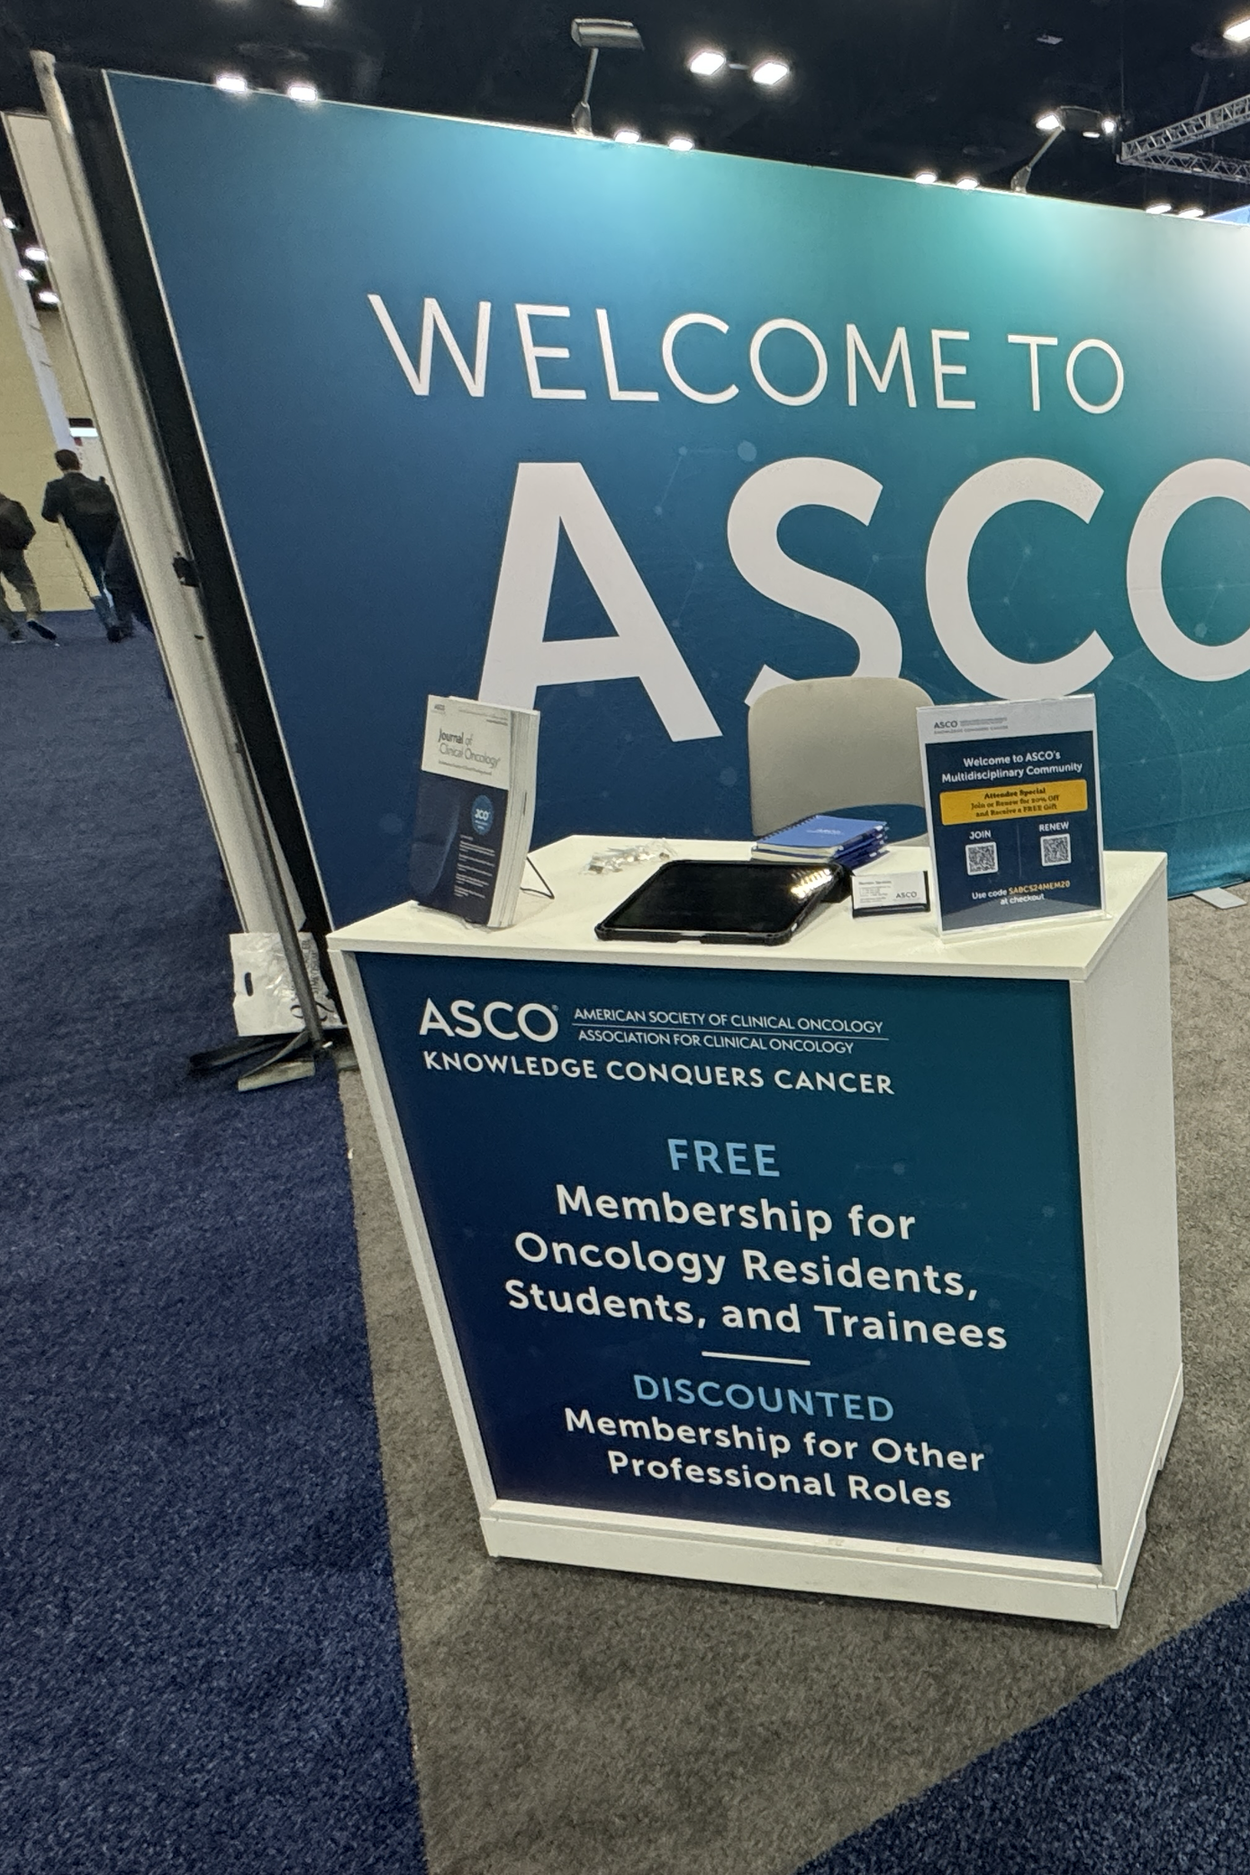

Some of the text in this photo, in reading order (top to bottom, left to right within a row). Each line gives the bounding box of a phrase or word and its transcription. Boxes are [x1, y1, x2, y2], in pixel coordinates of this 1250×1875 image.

[367, 294, 1124, 414] WELCOME TO
[934, 720, 958, 729] ASCO
[438, 728, 464, 745] Journal
[440, 742, 463, 758] Clinical
[465, 747, 501, 769] Oncology
[963, 751, 1061, 768] Welcome to ASCO's
[942, 762, 1083, 784] Multidisciplinary Community
[984, 787, 1046, 799] Attendee Special
[971, 802, 985, 810] Join
[990, 807, 1016, 816] Receive
[969, 830, 991, 840] JOIN
[1038, 822, 1069, 832] RENEW
[896, 891, 917, 899] ASCO
[972, 892, 986, 900] Use
[988, 888, 1007, 898] code
[1000, 893, 1045, 905] at checkout
[574, 1007, 883, 1034] AMERICAN SOCIETY OF CLINICAL ONCOLOGY
[578, 1029, 854, 1054] ASSOCIATION FOR CLINICAL ONCOLOGY
[423, 1050, 895, 1095] KNOWLEDGE CONQUERS CANCER
[667, 1138, 780, 1177] FREE
[556, 1184, 916, 1241] Membership for
[514, 1232, 979, 1301] Oncology Residents,
[504, 1279, 1008, 1351] Students, and Trainees
[633, 1374, 894, 1423] DISCOUNTED
[564, 1408, 985, 1472] Membership for Other
[608, 1450, 952, 1509] Professional Roles
